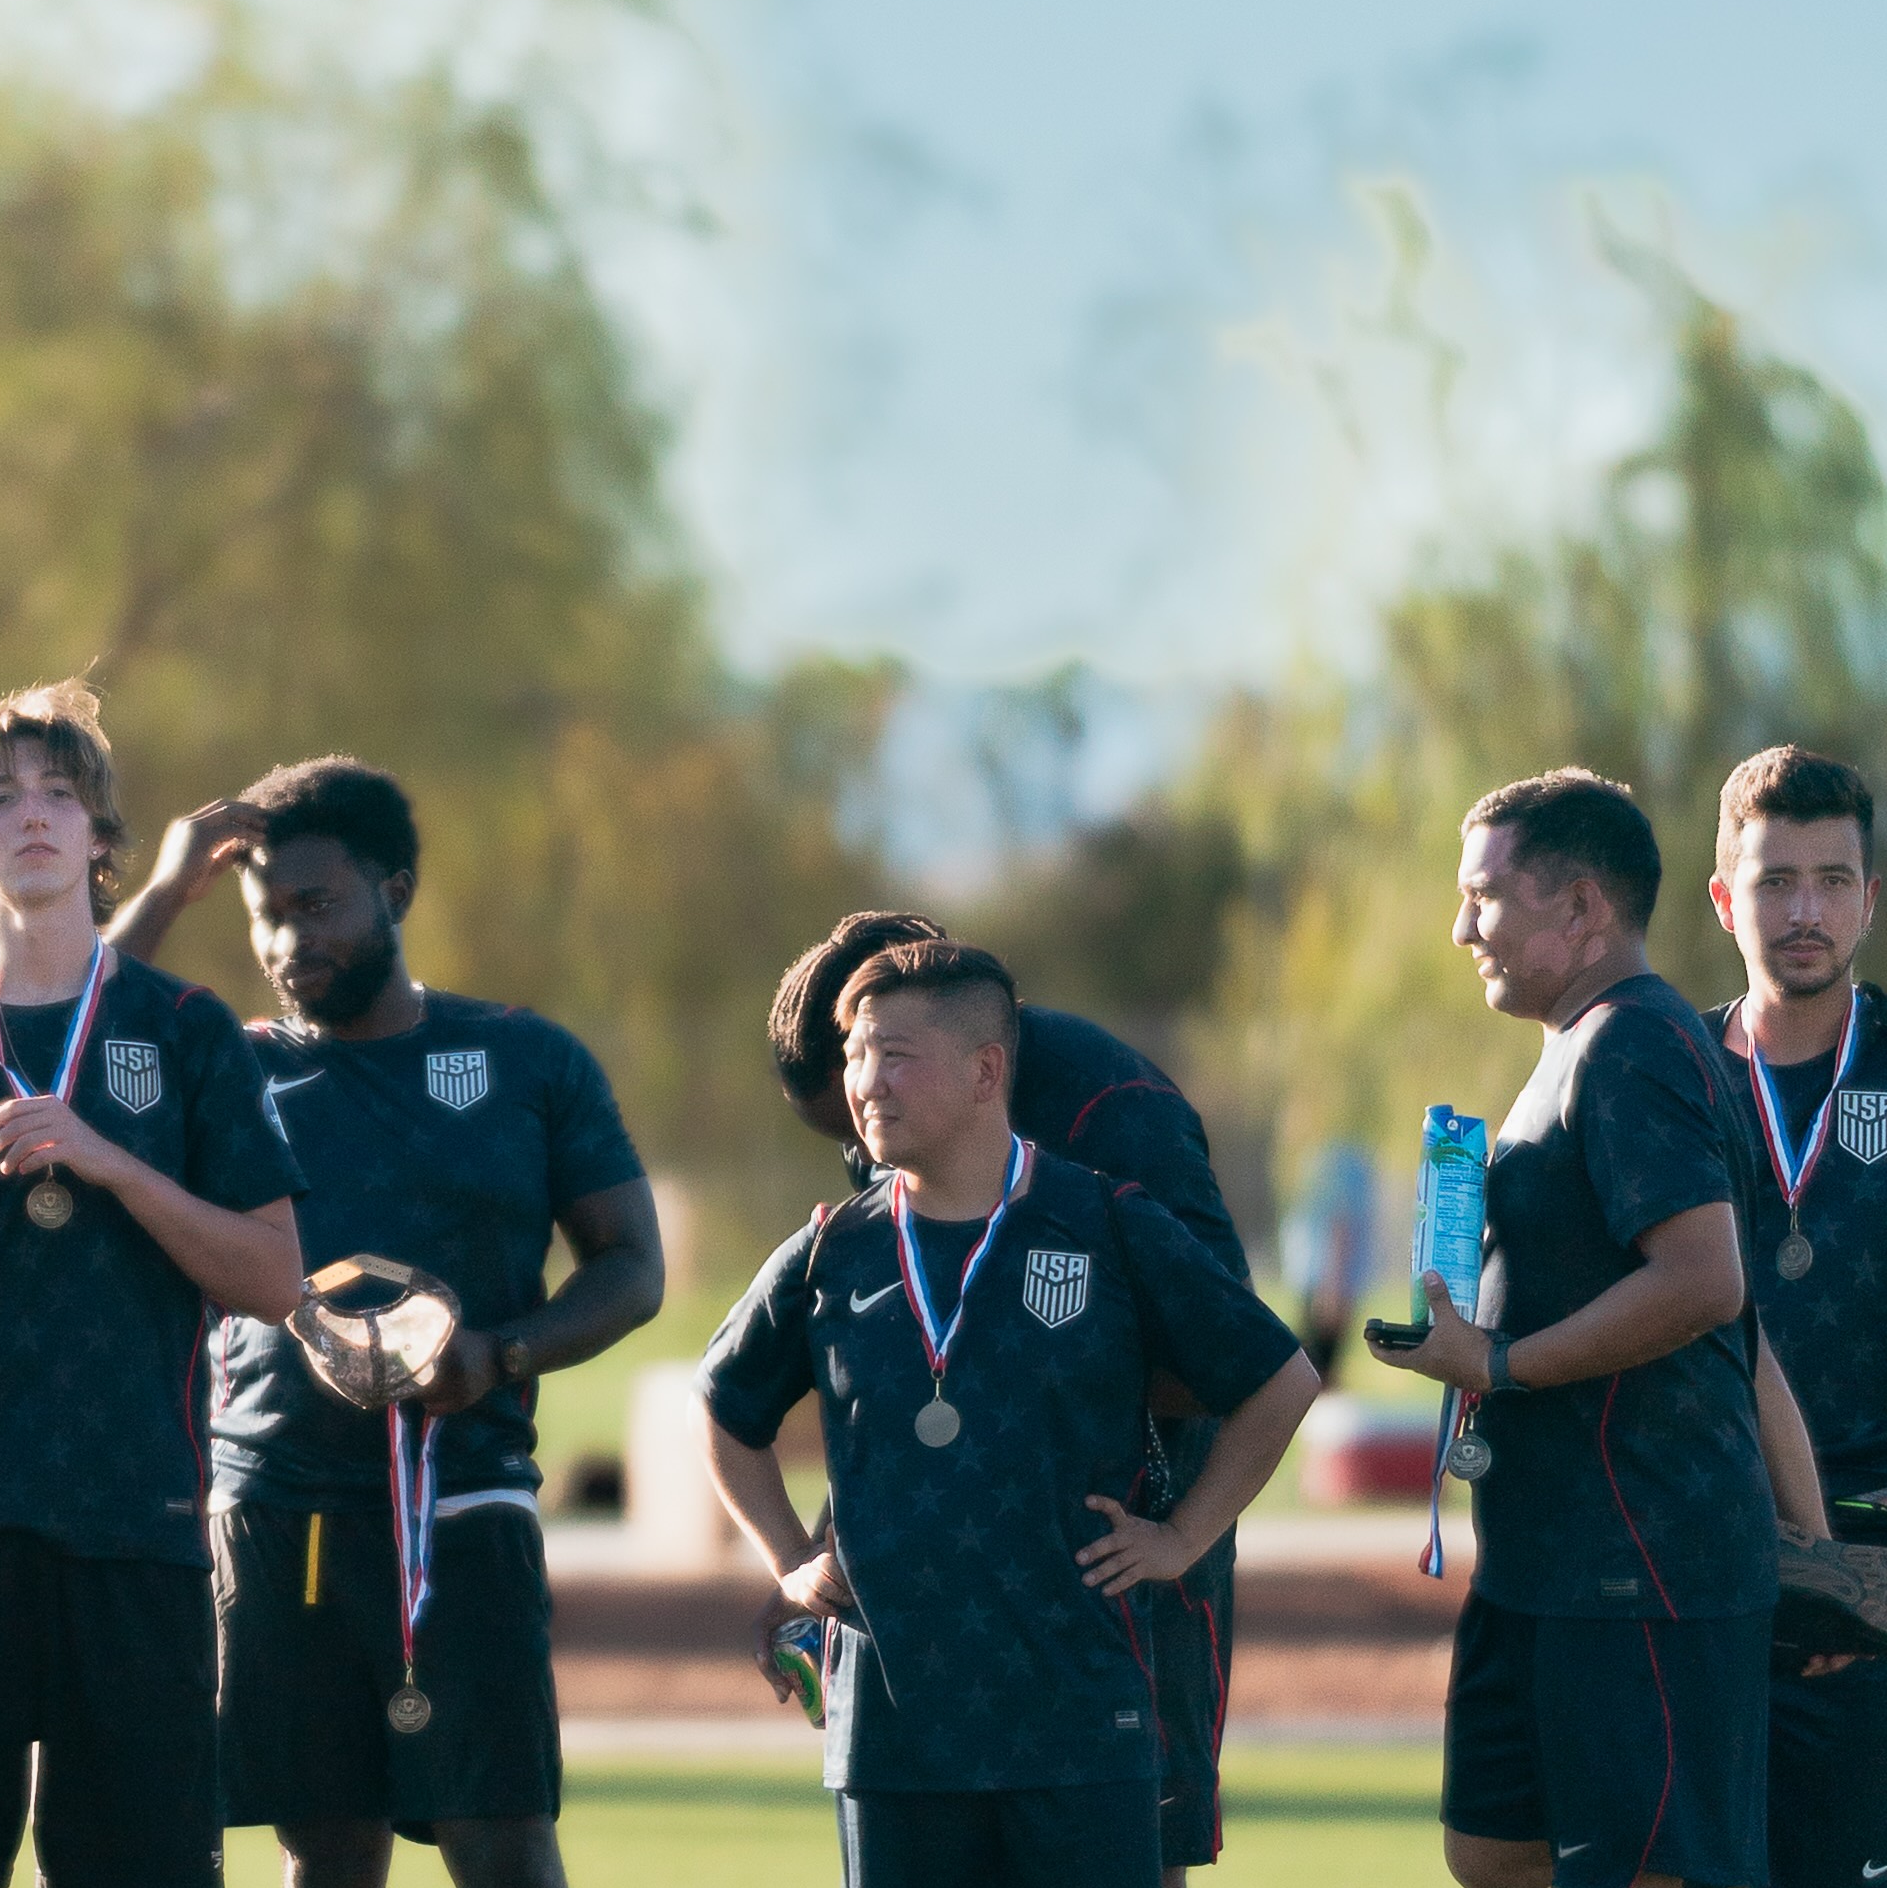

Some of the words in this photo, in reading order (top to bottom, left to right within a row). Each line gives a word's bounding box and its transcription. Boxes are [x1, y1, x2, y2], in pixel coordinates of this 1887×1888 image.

[112, 1046, 154, 1071] USA
[432, 1055, 482, 1074] USA
[1031, 1253, 1085, 1282] USA
